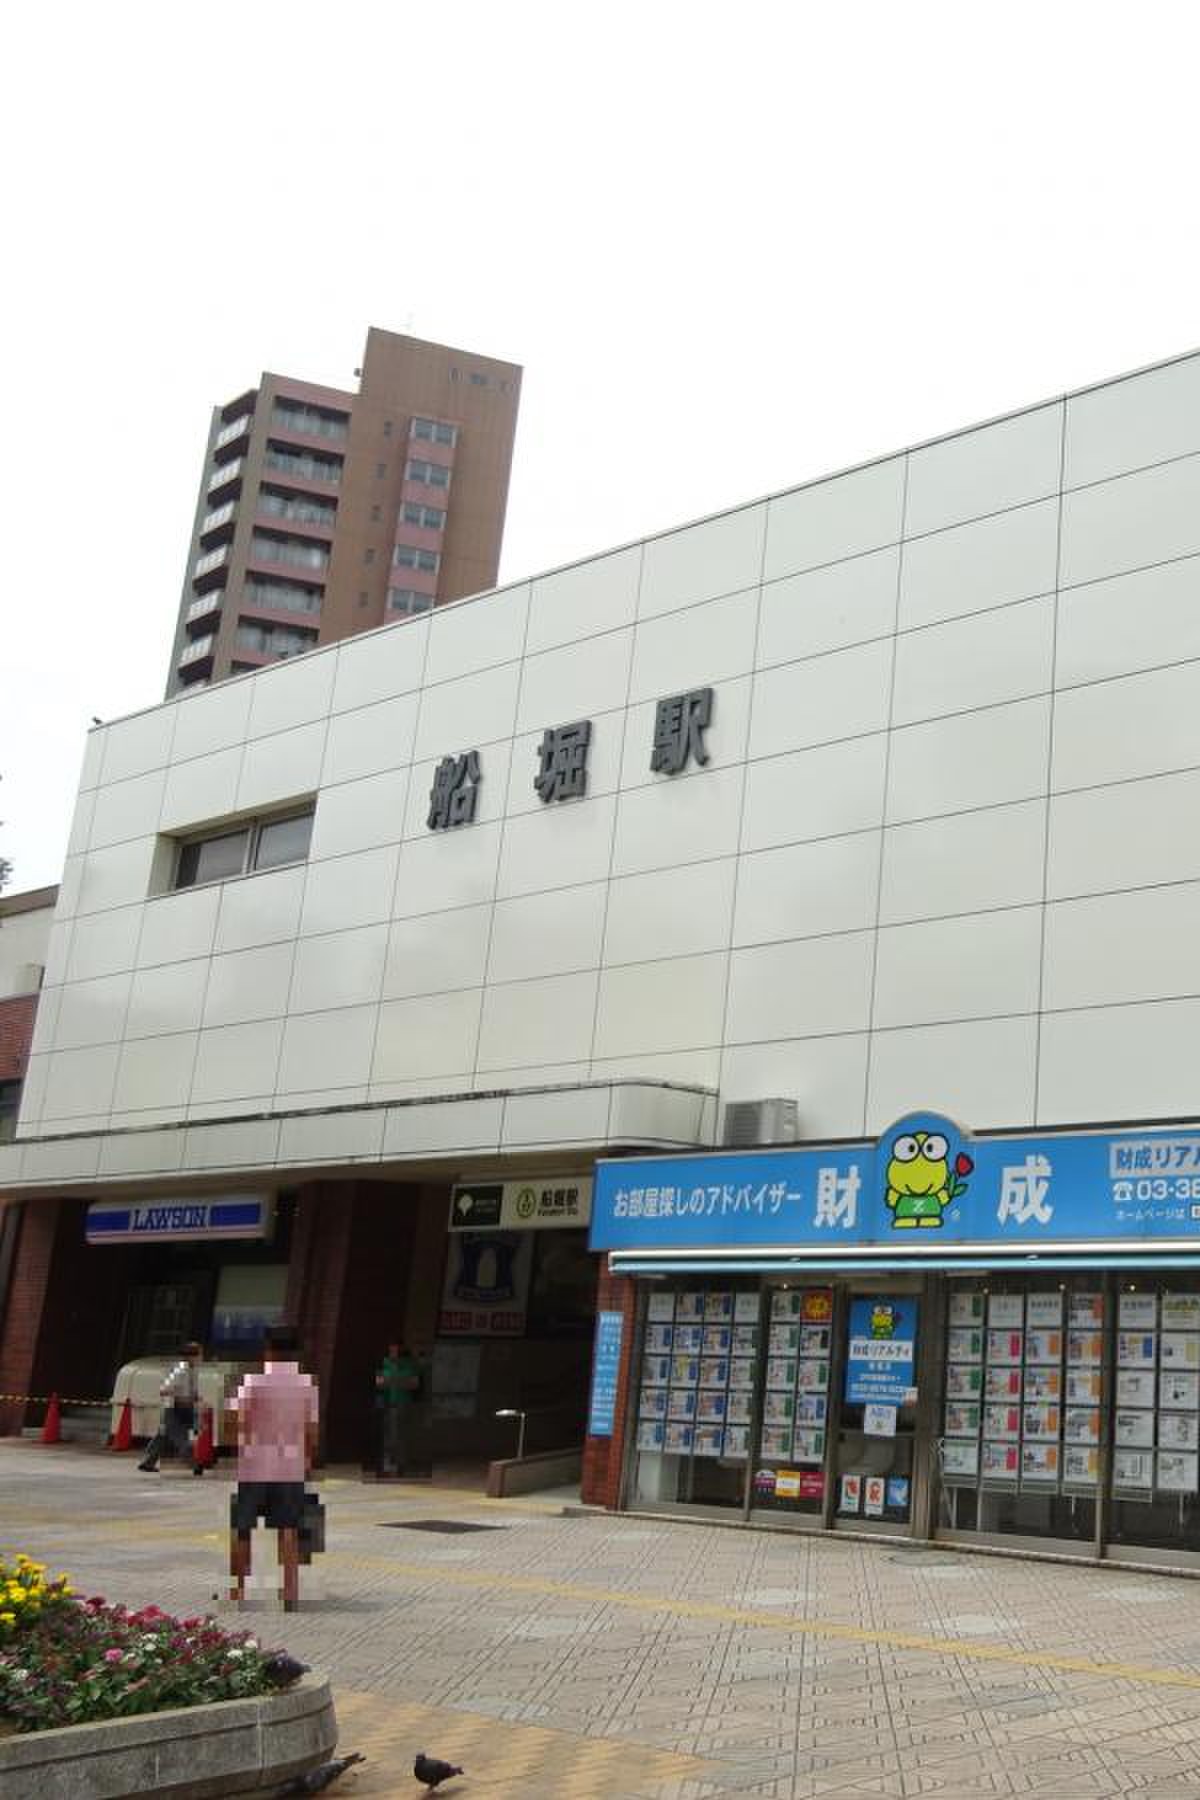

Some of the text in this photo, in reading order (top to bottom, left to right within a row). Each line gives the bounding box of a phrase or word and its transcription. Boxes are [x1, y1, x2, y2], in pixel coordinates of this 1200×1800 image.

[427, 687, 714, 830] 船堀駅
[132, 1206, 209, 1231] LAWSON
[614, 1181, 802, 1218] お部屋探しのアドバイザー
[813, 1154, 1055, 1228] 財 成
